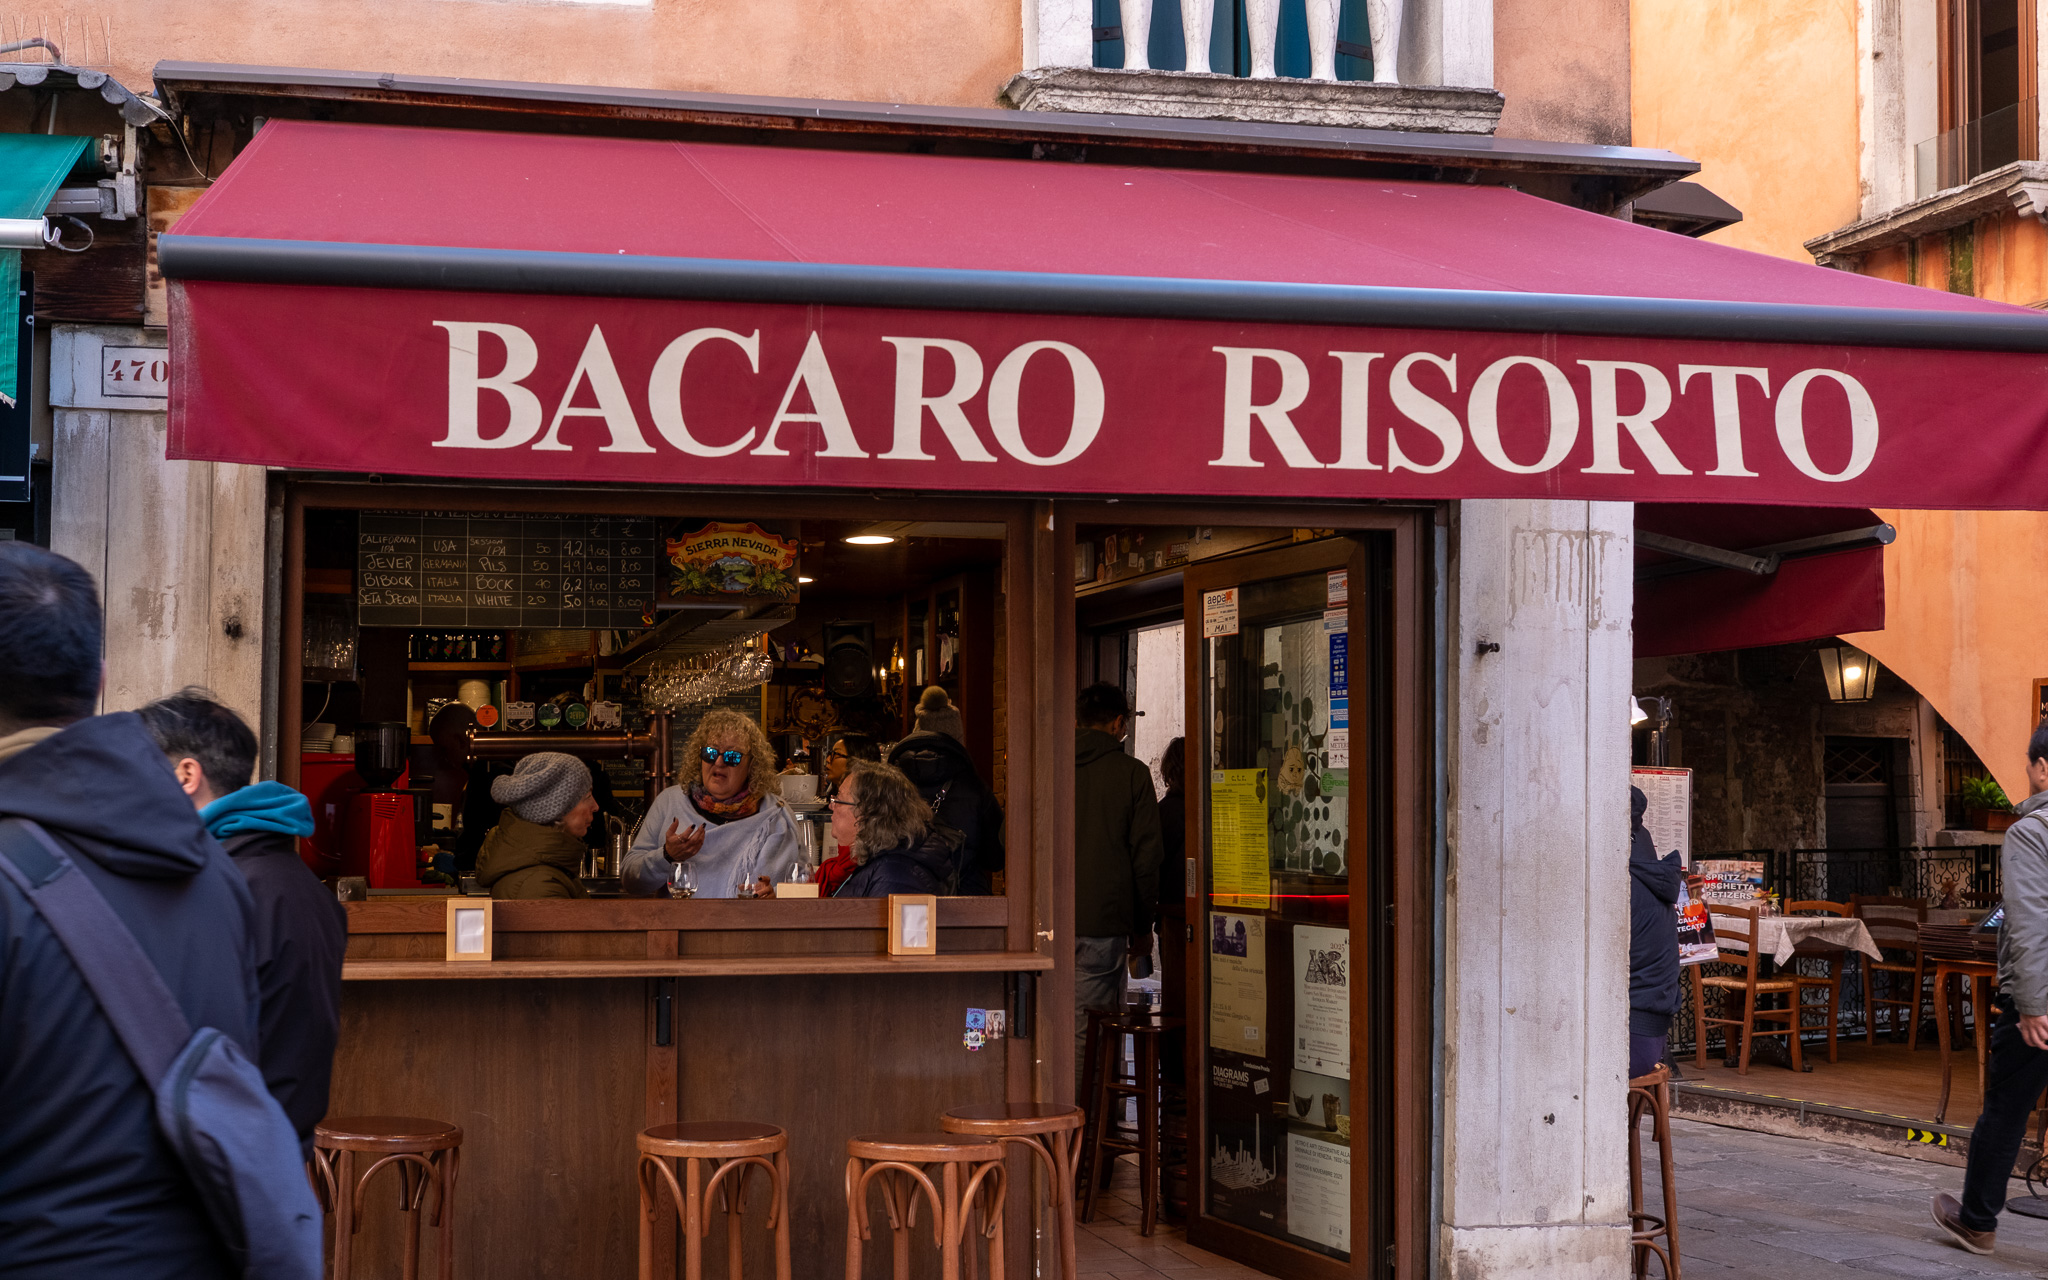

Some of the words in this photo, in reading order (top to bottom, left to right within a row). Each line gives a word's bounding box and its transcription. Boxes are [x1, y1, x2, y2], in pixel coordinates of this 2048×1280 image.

[432, 319, 1106, 467] BACARO
[1207, 345, 1879, 483] RISORTO
[360, 533, 416, 545] CALIFORNIA
[433, 540, 456, 552] USA
[470, 538, 503, 546] SESSION
[536, 542, 551, 554] 50
[563, 540, 584, 556] 4,2
[685, 538, 729, 555] SIERRA
[732, 537, 779, 557] NEVADA
[380, 545, 394, 553] IPA
[486, 546, 506, 556] IPA
[365, 554, 413, 570] JEVER
[479, 556, 507, 572] PILS
[532, 560, 549, 571] 50
[363, 573, 413, 588] BIBOCK
[427, 576, 459, 587] ITALIA
[475, 574, 514, 591] BOCK
[562, 577, 582, 592] 6,2
[358, 588, 382, 605] SETA
[427, 594, 463, 604] ITALIA
[474, 594, 513, 607] WHITE
[527, 596, 546, 605] 20
[1214, 624, 1228, 632] MAI
[1705, 873, 1740, 881] SPRITZ
[1704, 882, 1755, 890] USCHETTA
[1706, 891, 1752, 899] PETIZERS
[1677, 916, 1699, 925] CALA'
[1676, 922, 1706, 932] TECATO
[1330, 943, 1345, 952] 2025
[1213, 1065, 1249, 1082] DIAGRAMS
